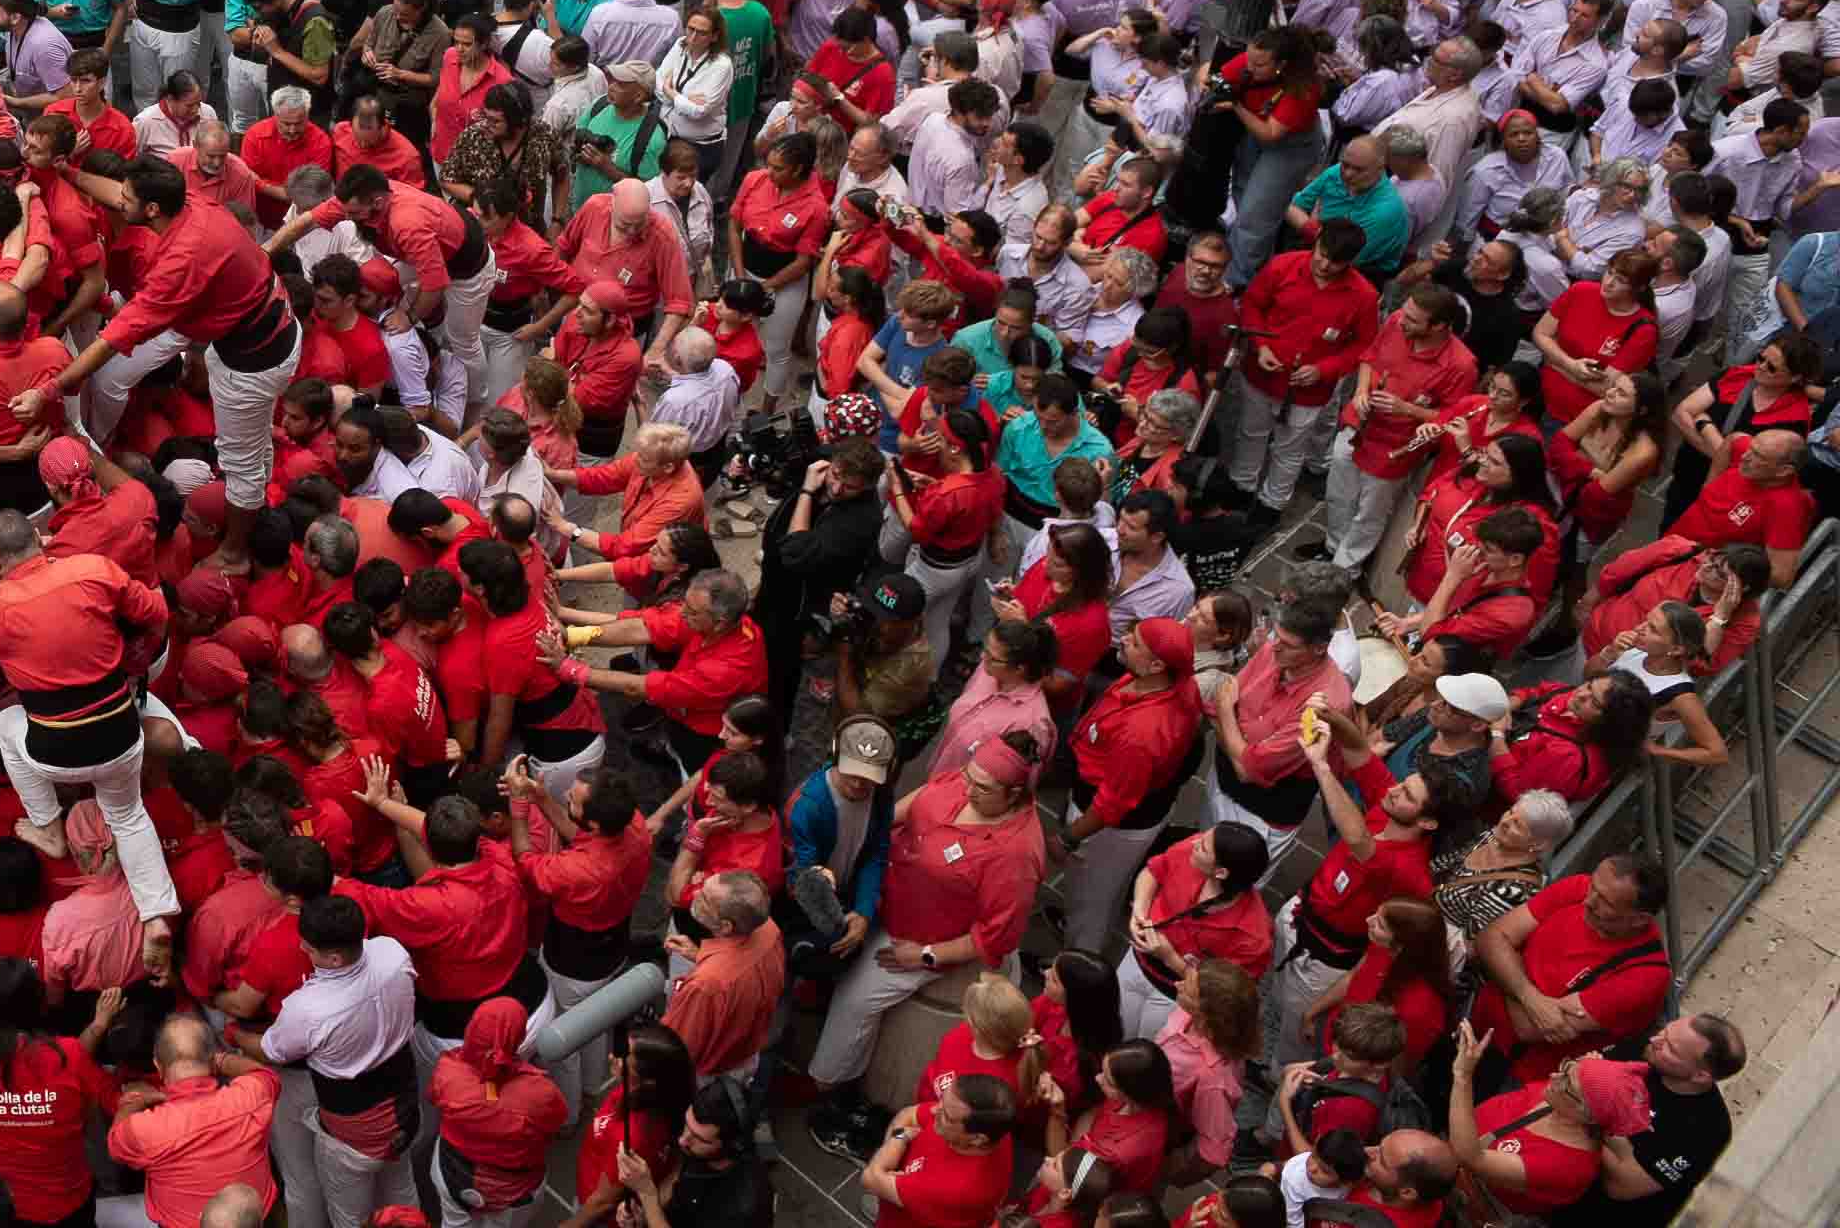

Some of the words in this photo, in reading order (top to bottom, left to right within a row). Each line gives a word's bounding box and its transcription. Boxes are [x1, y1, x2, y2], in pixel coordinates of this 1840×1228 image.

[24, 1090, 42, 1103] de
[45, 1088, 57, 1102] la
[11, 1103, 52, 1116] ciutat
